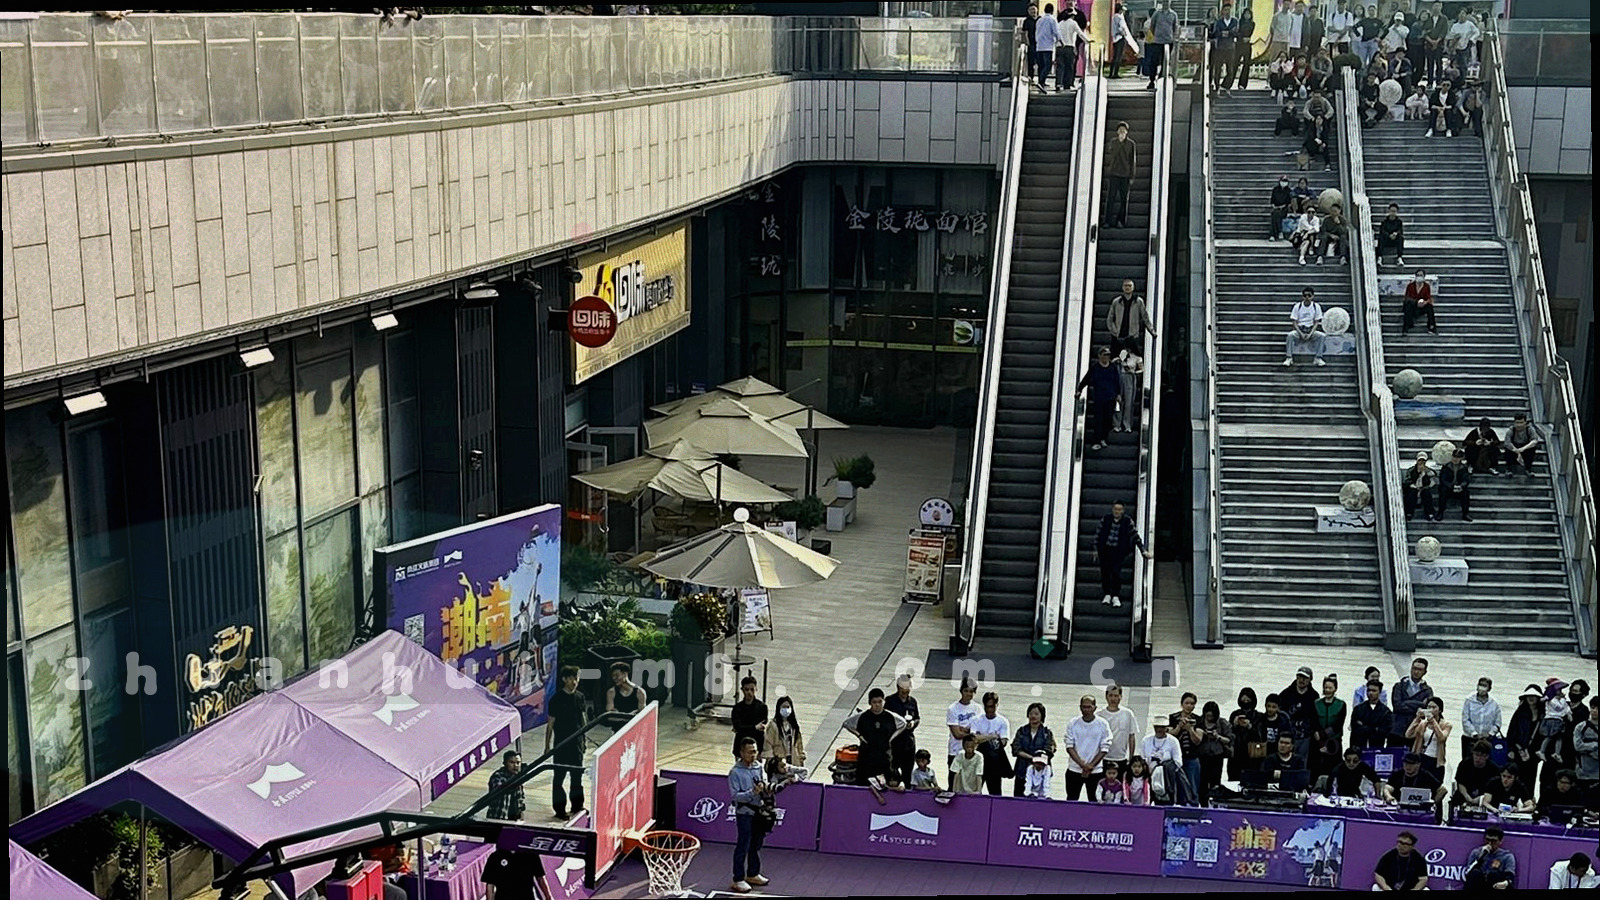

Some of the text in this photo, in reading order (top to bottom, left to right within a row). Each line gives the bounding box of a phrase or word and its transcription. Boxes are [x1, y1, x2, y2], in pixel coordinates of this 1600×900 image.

[572, 310, 611, 328] 回味
[1048, 829, 1134, 846] 南京文旅集团
